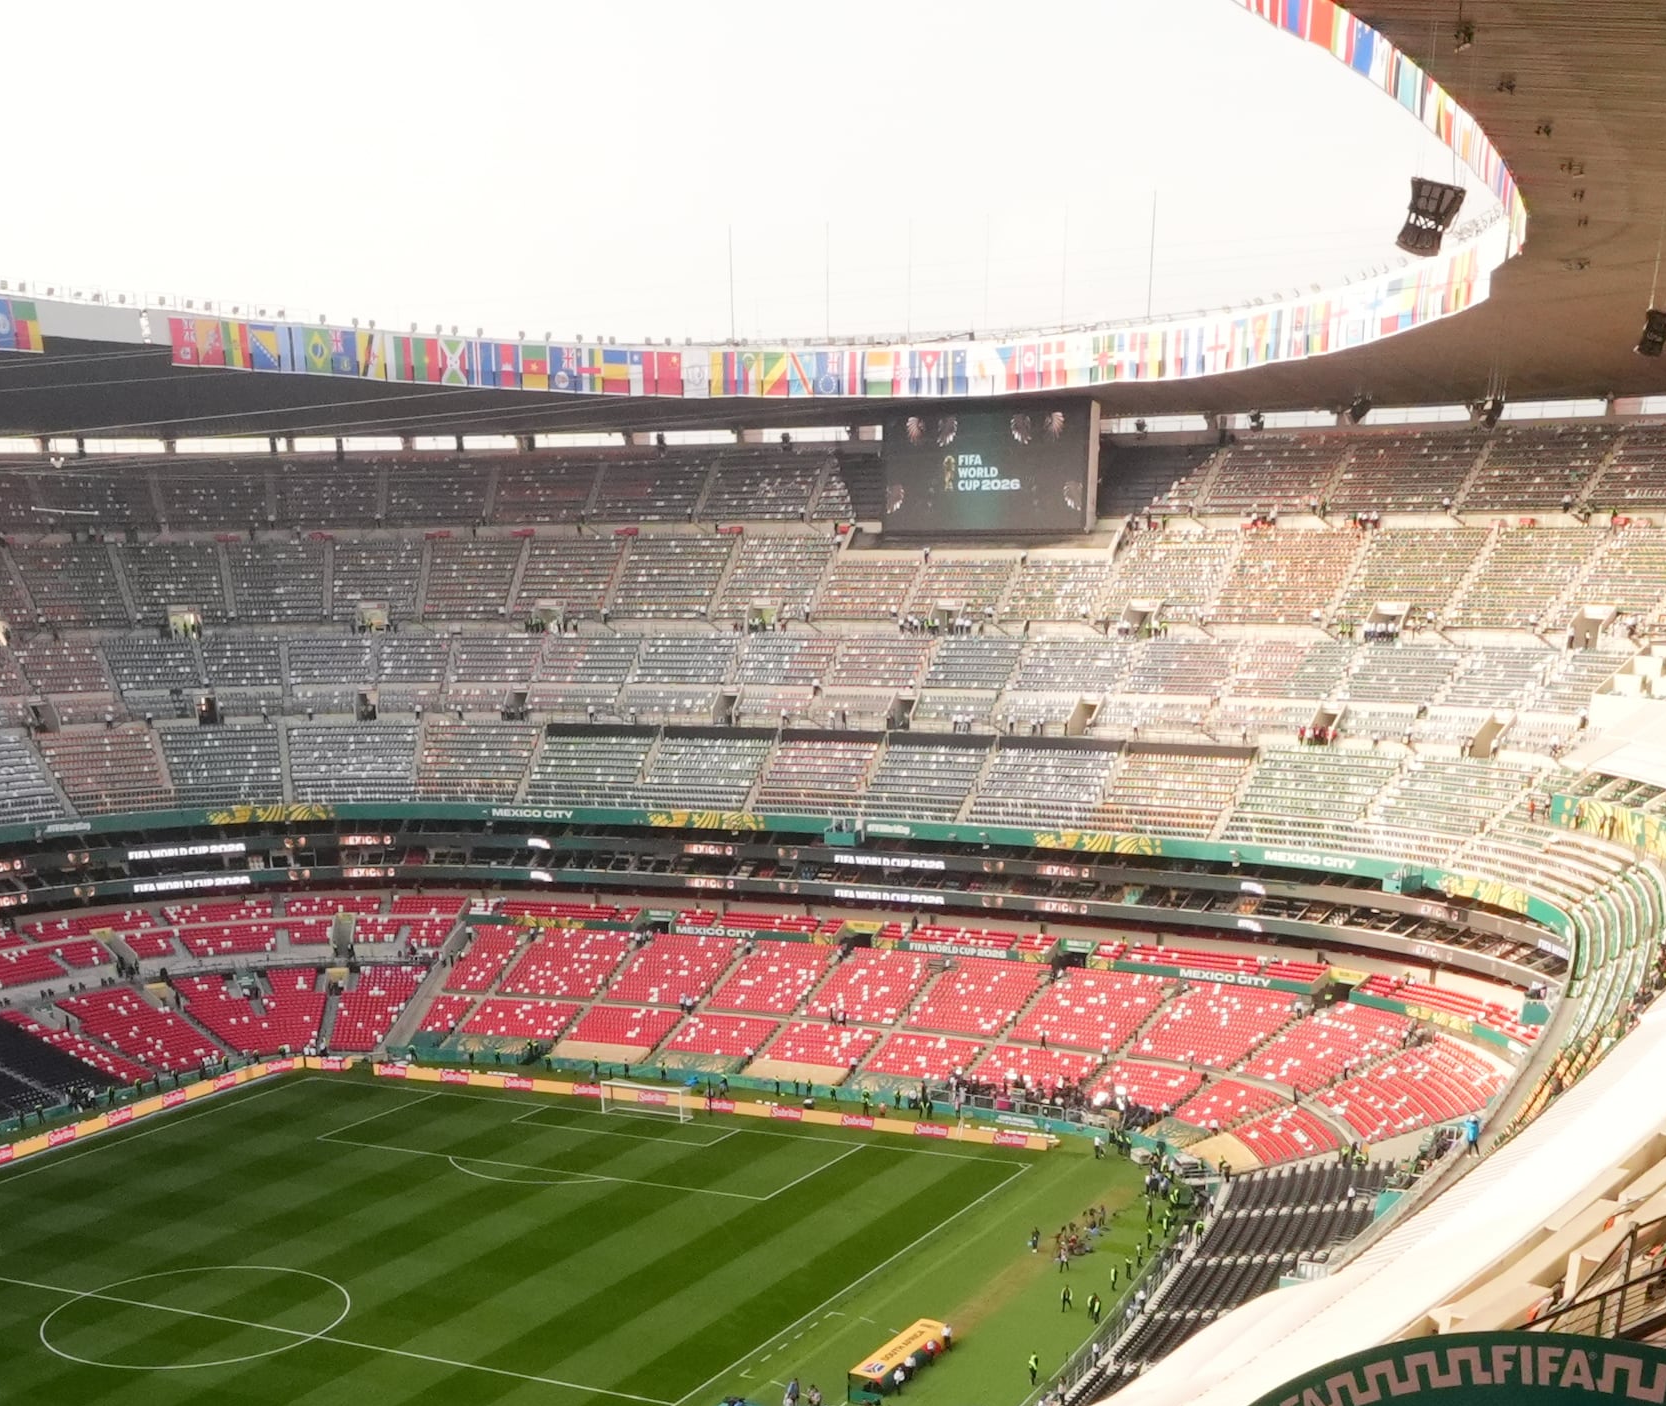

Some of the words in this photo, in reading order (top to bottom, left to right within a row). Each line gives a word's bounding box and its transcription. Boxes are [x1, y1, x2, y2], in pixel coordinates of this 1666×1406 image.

[958, 454, 982, 466] FIFA
[958, 466, 998, 478] WORLD
[958, 480, 980, 491] CUP
[981, 479, 1021, 490] 2026
[492, 808, 542, 818] MEXICO
[544, 809, 573, 819] CITY
[1265, 850, 1321, 866] MEXICO
[1323, 855, 1357, 870] CITY
[676, 925, 725, 936] MEXICO
[726, 928, 757, 938] CITY
[909, 943, 927, 953] FIFA
[928, 944, 955, 955] WORLD
[956, 946, 974, 956] CUP
[976, 948, 1007, 959] 2026
[1180, 969, 1235, 984] MEXICO
[1237, 975, 1271, 988] CITY
[267, 1059, 293, 1073] Sabritas
[379, 1066, 405, 1077] Sabritas
[441, 1072, 468, 1083] Sabritas
[505, 1078, 532, 1089] Sabritas
[108, 1108, 132, 1126] Sabritas
[771, 1106, 802, 1119] Sabritas
[842, 1115, 874, 1129] Sabritas
[49, 1127, 76, 1147] Sabritas
[915, 1123, 948, 1137] Sabritas
[994, 1132, 1027, 1146] Sabritas
[880, 1342, 905, 1362] SOUTH
[902, 1329, 925, 1350] AFRICA
[1490, 1345, 1598, 1391] FIFA
